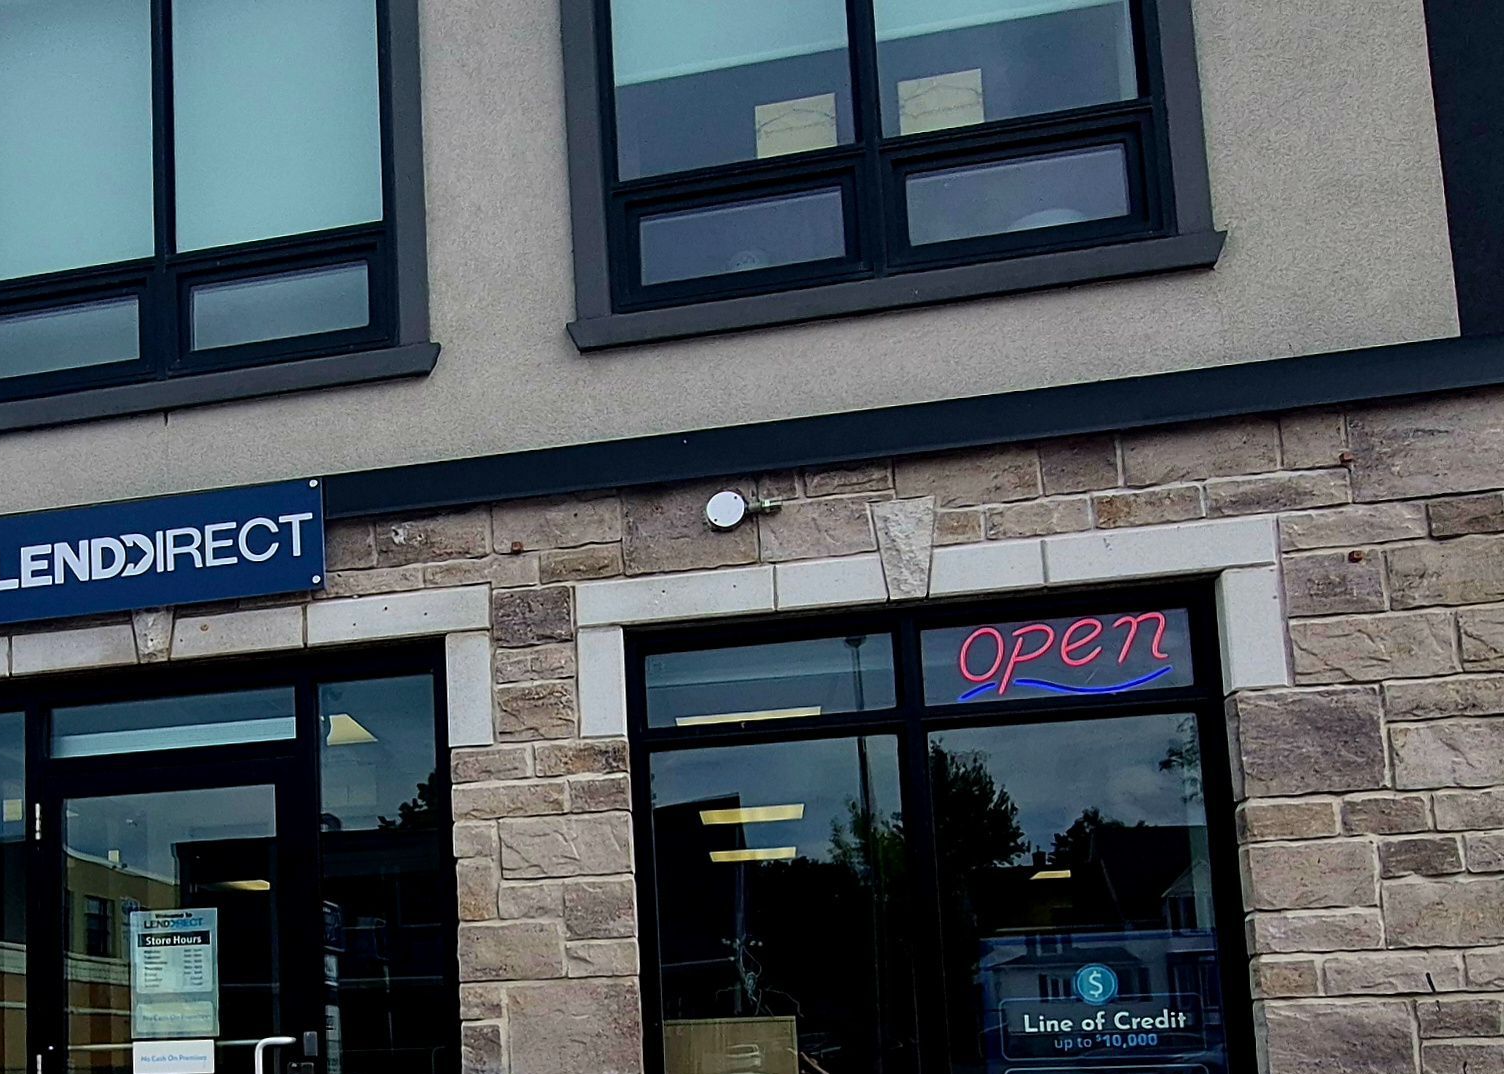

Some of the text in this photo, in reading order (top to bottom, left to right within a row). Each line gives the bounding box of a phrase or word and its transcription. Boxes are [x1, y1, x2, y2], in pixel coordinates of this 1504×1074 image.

[146, 935, 202, 946] Store Hours
[1023, 1009, 1186, 1033] Line of Credit
[1054, 1033, 1158, 1051] up to $10,000
[168, 1054, 178, 1062] On
